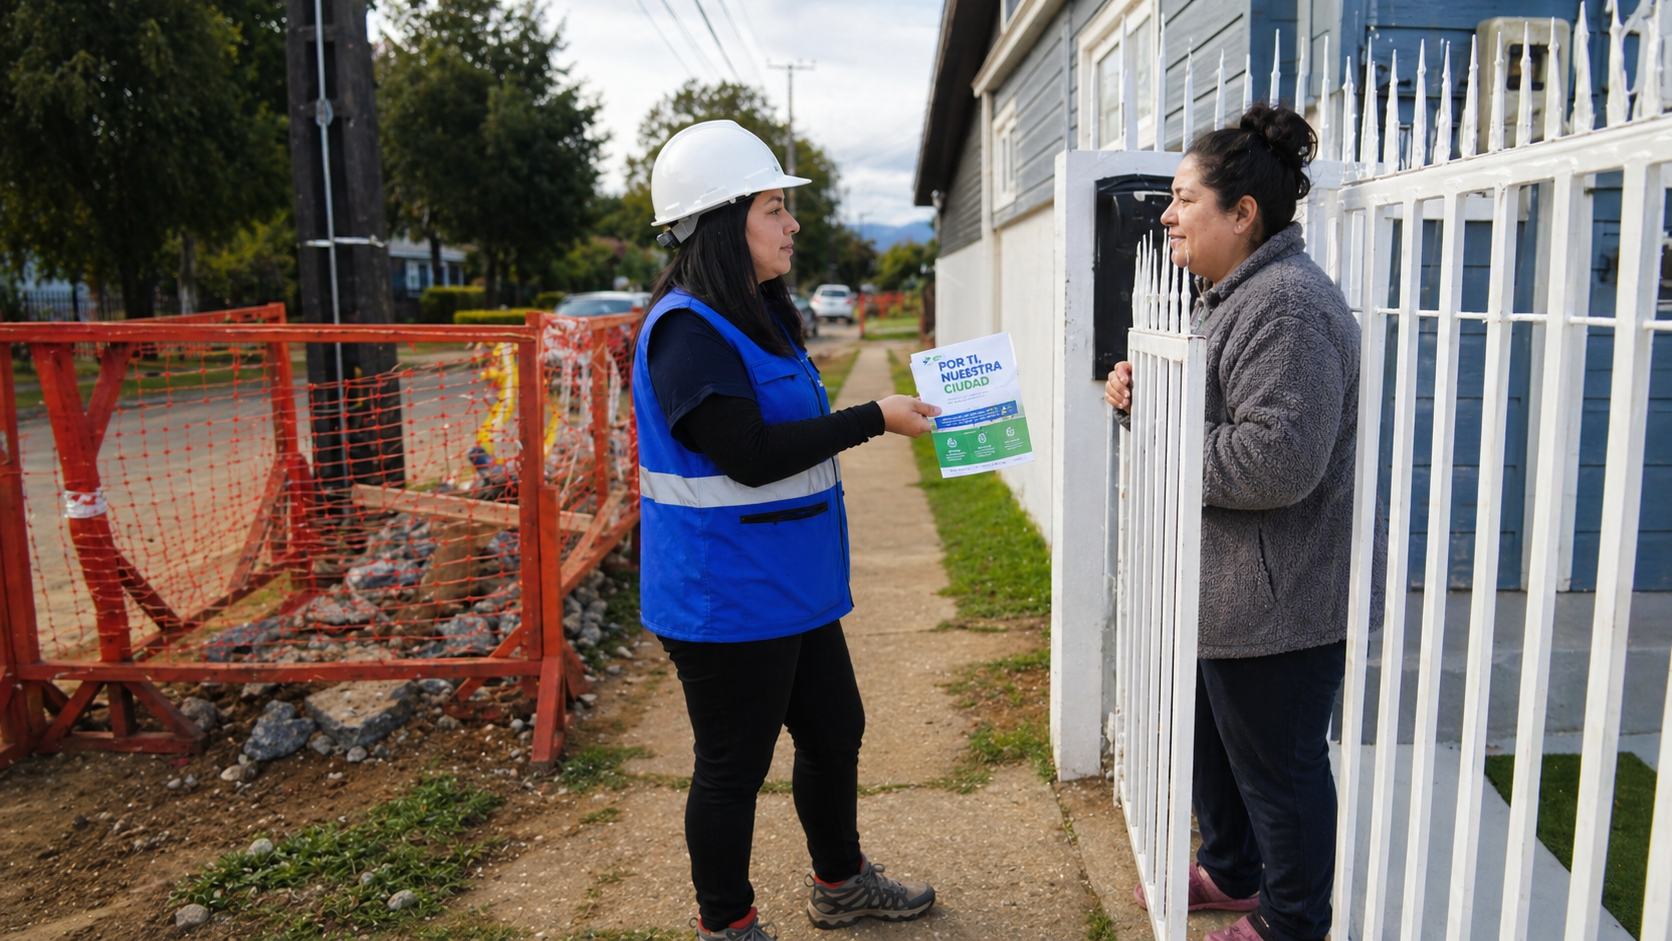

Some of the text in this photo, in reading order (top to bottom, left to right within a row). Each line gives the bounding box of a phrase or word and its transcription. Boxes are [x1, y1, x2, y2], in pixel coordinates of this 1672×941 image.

[938, 358, 965, 372] POR
[966, 354, 982, 365] TI,
[944, 376, 990, 394] CIUDAD
